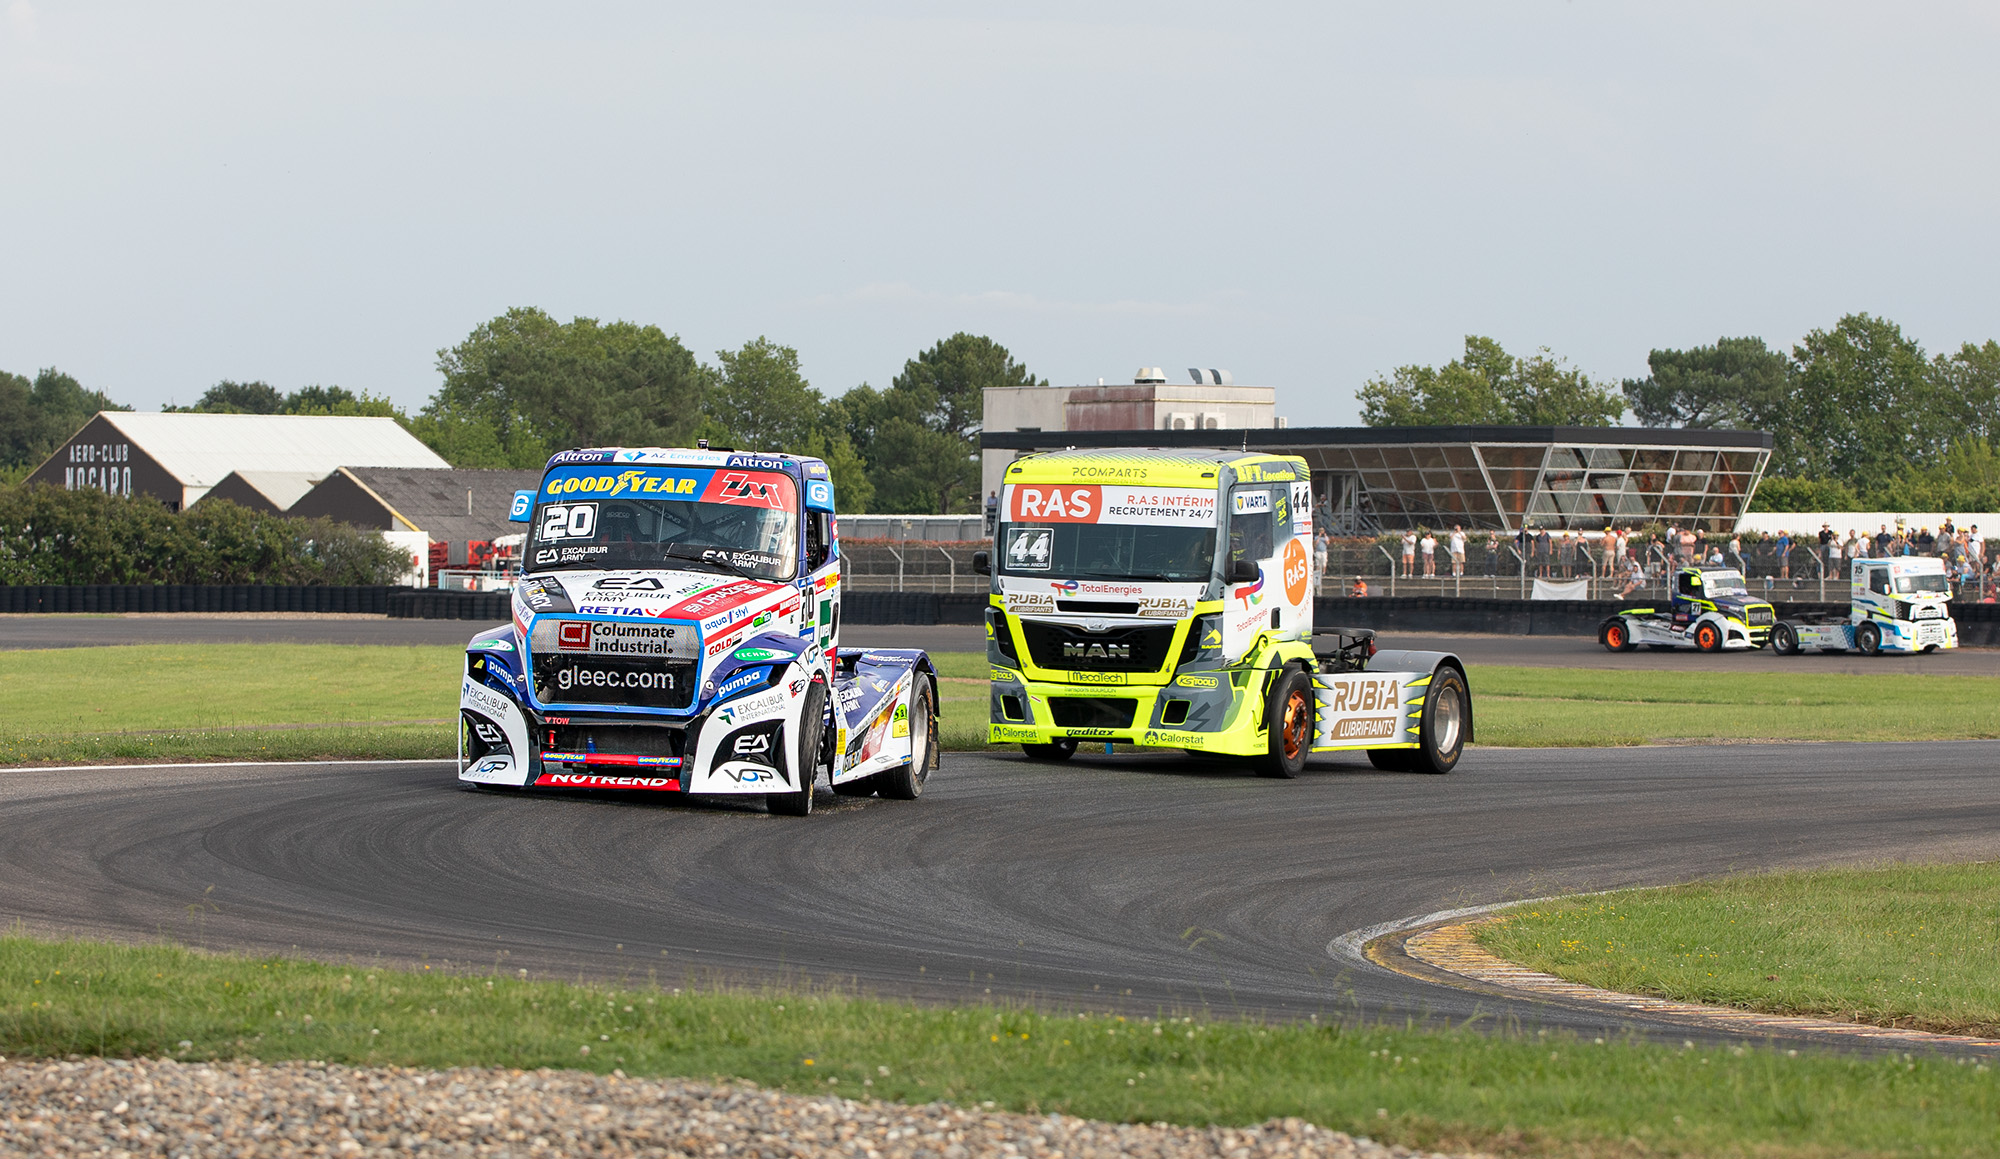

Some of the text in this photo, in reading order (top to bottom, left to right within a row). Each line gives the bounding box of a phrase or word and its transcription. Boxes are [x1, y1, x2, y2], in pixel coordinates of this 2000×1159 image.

[69, 444, 129, 462] AERO-CLUB
[554, 452, 603, 462] Altron
[669, 453, 721, 461] Energies
[729, 457, 784, 469] Altron
[1262, 469, 1296, 481] Location
[1163, 495, 1214, 507] INTÉRIM
[1245, 496, 1268, 508] VARTA
[1293, 486, 1309, 513] 44
[1109, 507, 1213, 519] RECRUTEMENT 24/7
[543, 505, 594, 539] 20
[561, 546, 608, 555] EXCALIBUR
[1010, 533, 1050, 562] 44
[560, 554, 585, 562] ARMY
[733, 552, 781, 566] EXCALIBUR
[732, 560, 758, 569] ARMY
[585, 591, 671, 599] EXCALIBUR
[1081, 584, 1142, 597] TotalEnergies
[579, 606, 643, 616] RETIA
[1014, 606, 1052, 614] LUBRIFIANTS
[704, 616, 728, 630] aqua
[593, 623, 675, 638] Columnate
[708, 637, 733, 656] GOLD
[1063, 642, 1130, 658] MAN
[558, 665, 674, 690] gleec.com
[1072, 672, 1123, 683] MecaTech
[1193, 678, 1216, 686] TOOLS
[718, 671, 761, 697] pumpa
[470, 687, 508, 713] EXCALIBUR
[738, 693, 785, 714] EXCALIBUR
[740, 704, 786, 721] INTERNATIONAL
[552, 717, 570, 725] TOW
[1002, 728, 1038, 738] Calorstat
[1339, 720, 1395, 737] LUBRIFIANTS
[1160, 732, 1204, 744] Calorstat
[551, 774, 668, 787] NUTREND
